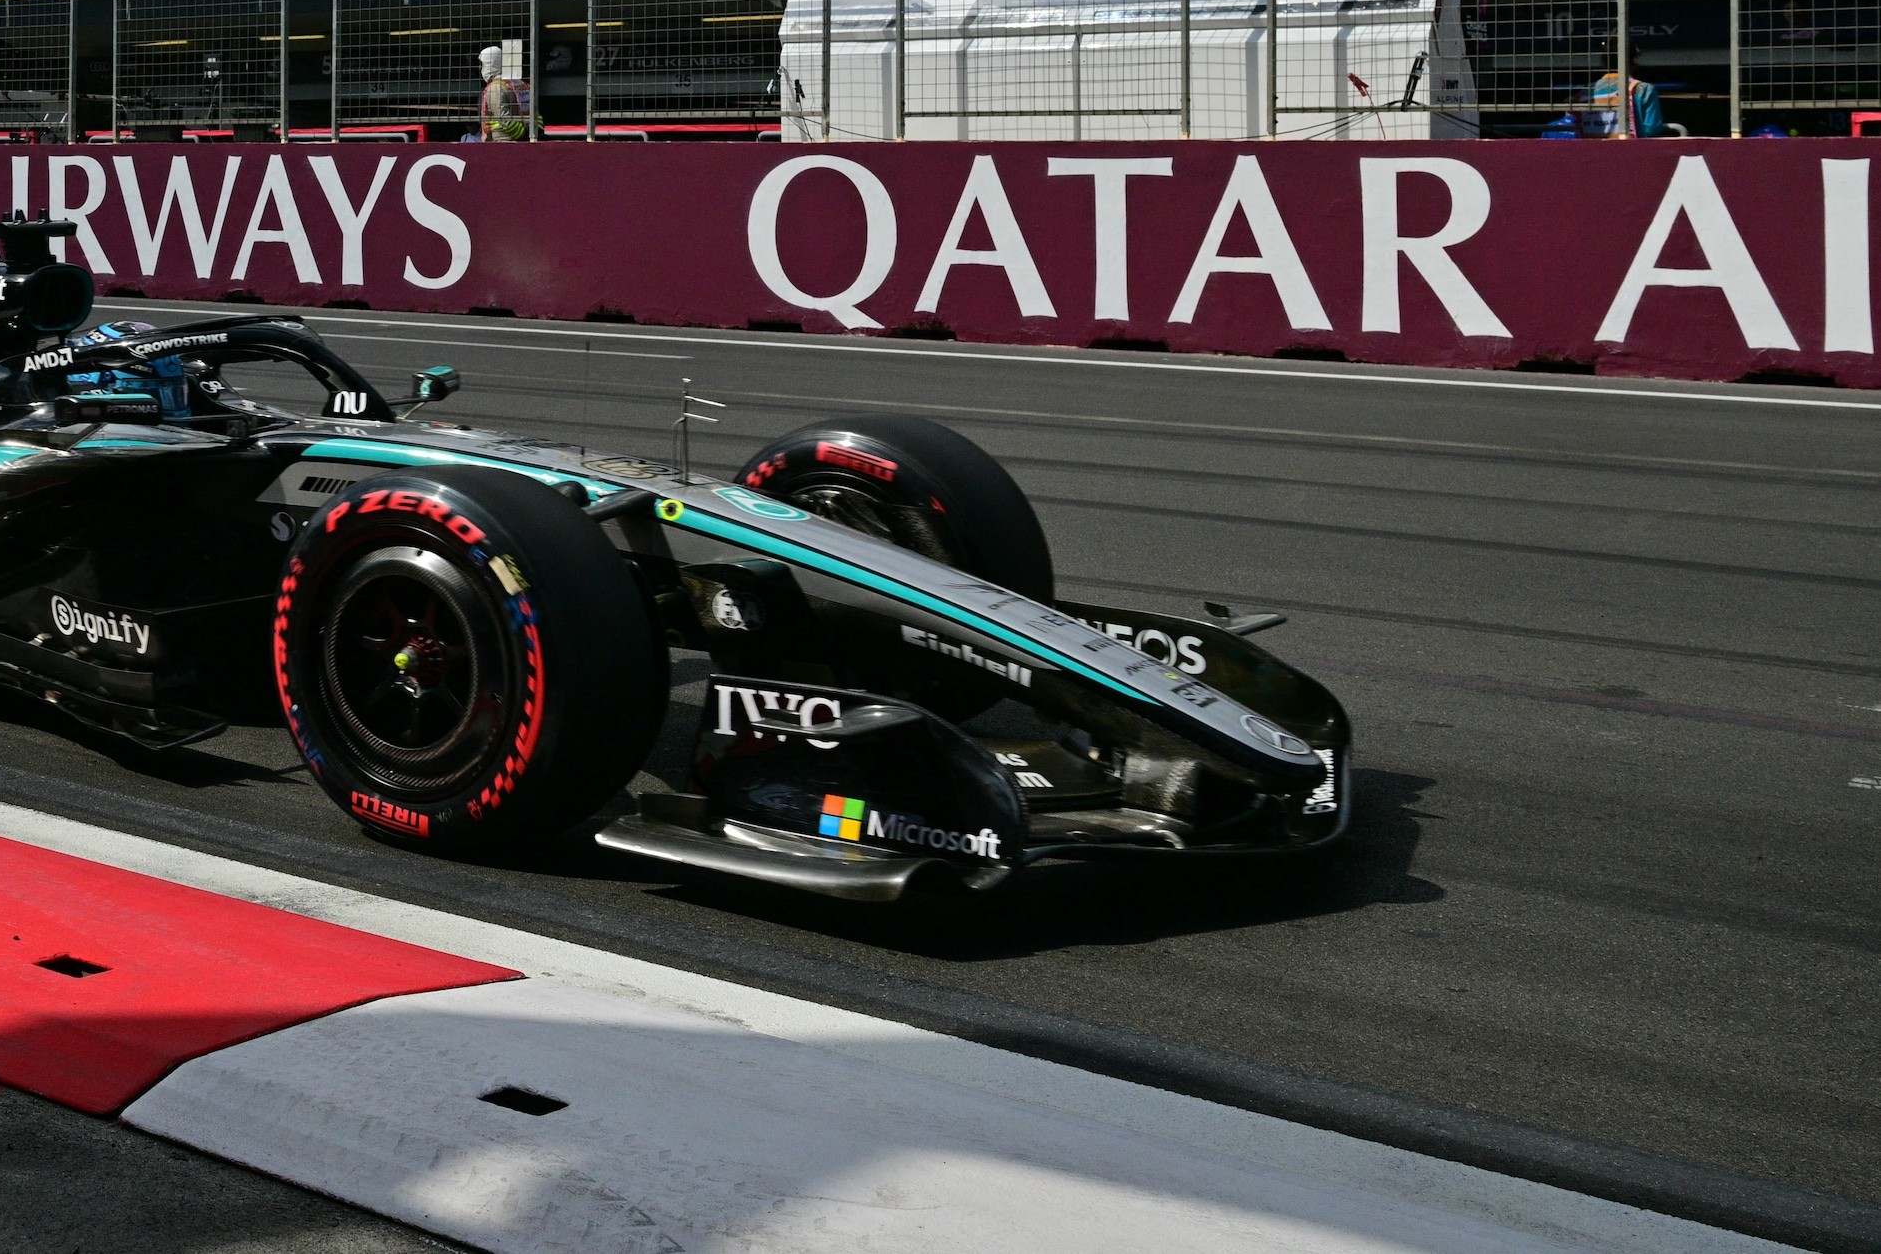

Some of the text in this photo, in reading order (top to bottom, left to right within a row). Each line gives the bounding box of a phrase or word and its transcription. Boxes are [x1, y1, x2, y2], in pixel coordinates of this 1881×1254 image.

[595, 47, 619, 67] 27
[371, 82, 385, 93] 34
[1436, 95, 1464, 104] ALPINE
[747, 154, 1514, 337] QATAR
[24, 350, 60, 373] AMD
[134, 333, 229, 356] CROWDSTRIKE
[105, 403, 159, 415] PETRONAS
[324, 489, 488, 545] P ZERO
[900, 624, 1033, 688] Einhell
[713, 684, 843, 750] IWC
[350, 789, 431, 841] PIRELLI
[866, 809, 1002, 860] Microsoft
